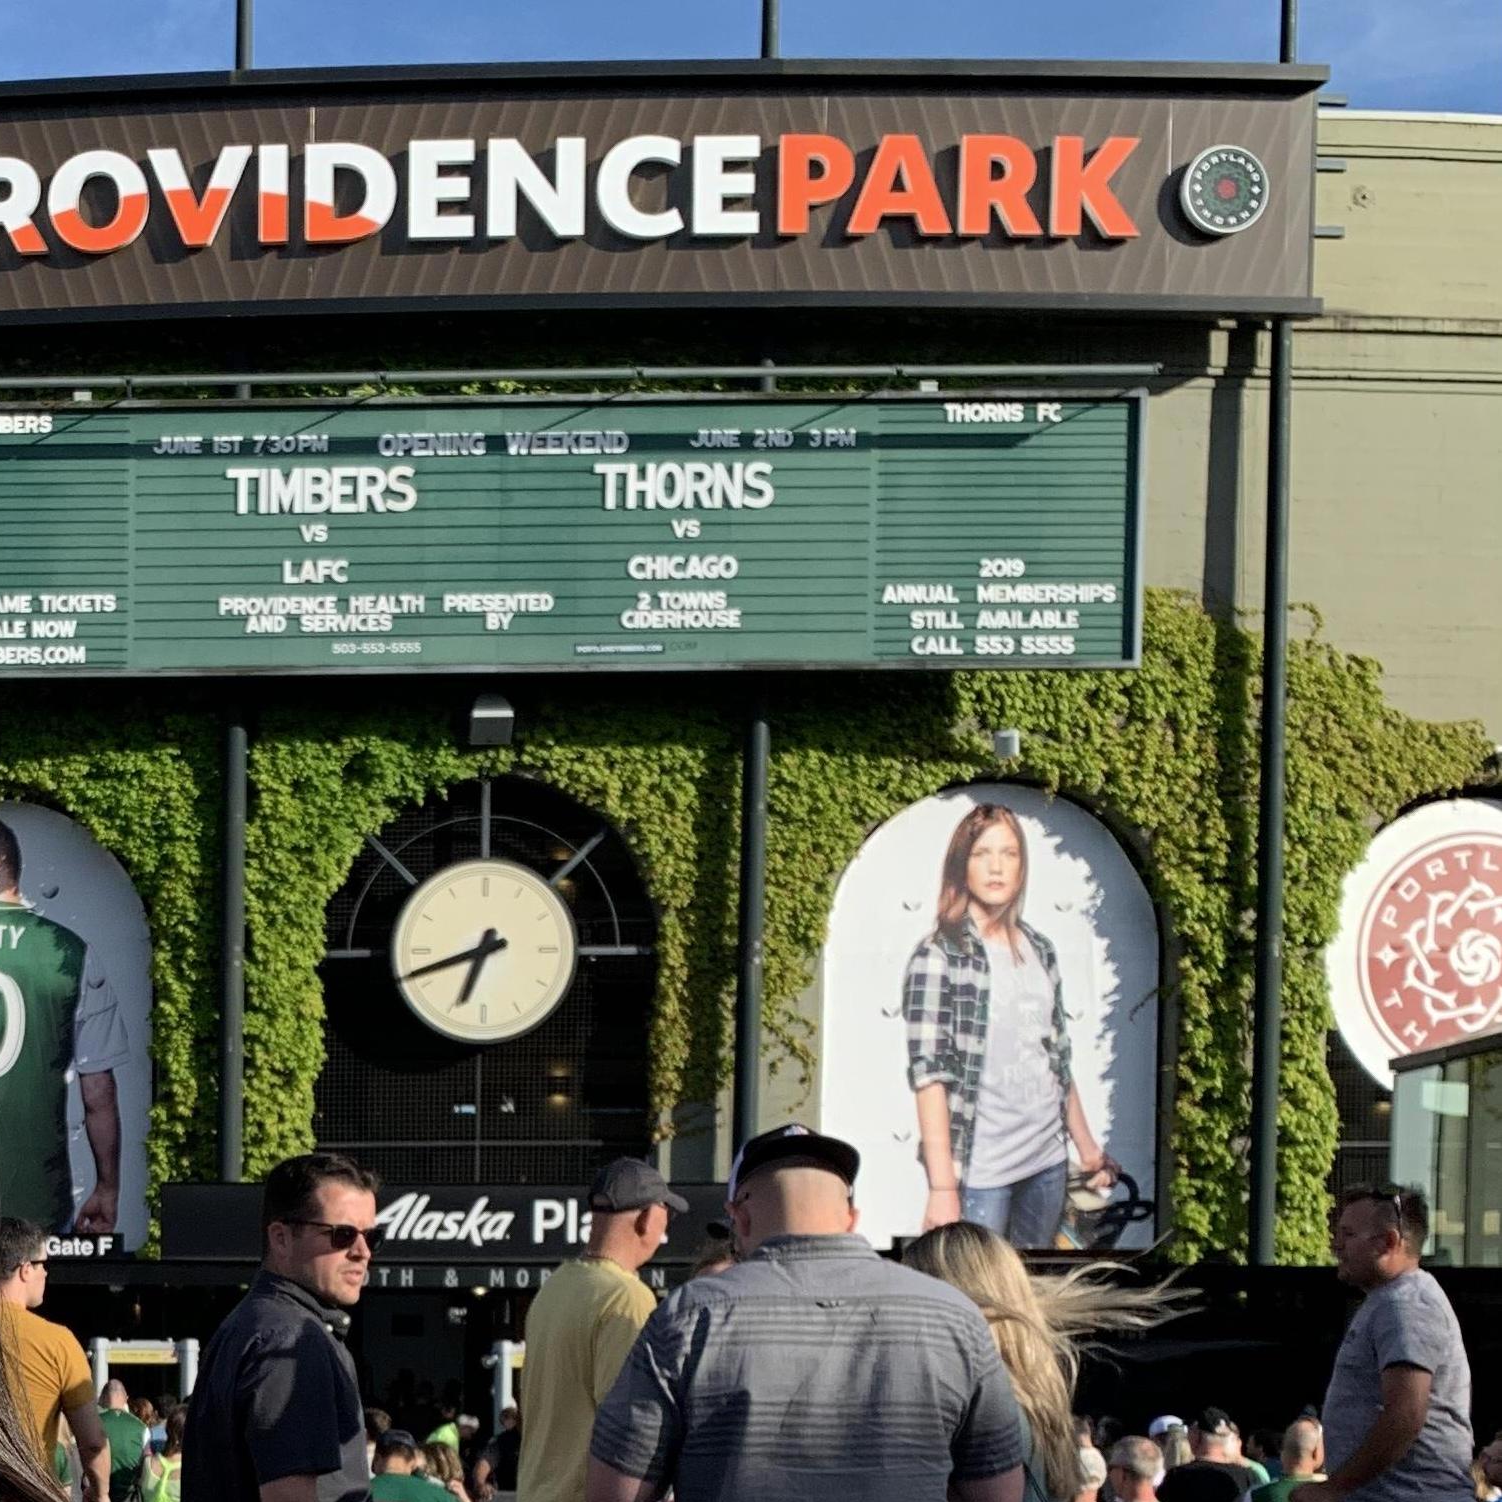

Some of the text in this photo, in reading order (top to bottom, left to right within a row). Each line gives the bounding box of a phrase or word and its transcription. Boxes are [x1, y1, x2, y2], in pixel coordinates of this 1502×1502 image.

[1193, 152, 1261, 183] PORTLAND
[777, 133, 1141, 237] PARK
[944, 402, 1063, 423] THORNS FC
[153, 435, 203, 455] JUNE
[212, 435, 244, 454] 1ST
[378, 431, 630, 457] OPENING WEEKEND
[689, 429, 742, 448] JUNE
[752, 429, 795, 448] 2ND
[226, 466, 418, 515] TIMBERS
[593, 461, 775, 510] THORNS
[299, 524, 329, 543] VS
[671, 519, 701, 538] VS
[282, 559, 349, 584] LAFC
[627, 554, 739, 580] CHICAGO
[978, 557, 1026, 578] 2019
[39, 594, 117, 613] TICKETS
[218, 593, 555, 615] PROVIDENCE HEALTH PRESENTED
[637, 590, 728, 610] 2 TOWNS
[882, 583, 1117, 604] ANNUAL MEMBERSHIPS
[30, 619, 78, 638] NOW
[245, 612, 514, 634] AND SERVICES BY
[619, 609, 742, 630] CIDERHOUSE
[910, 609, 1080, 630] STILL AVAILABLE
[910, 636, 1076, 656] CALL 553 5555
[1380, 850, 1502, 929] PORTL
[374, 1191, 516, 1247] Alaska
[45, 1235, 114, 1257] Gate F
[444, 1268, 459, 1288] &
